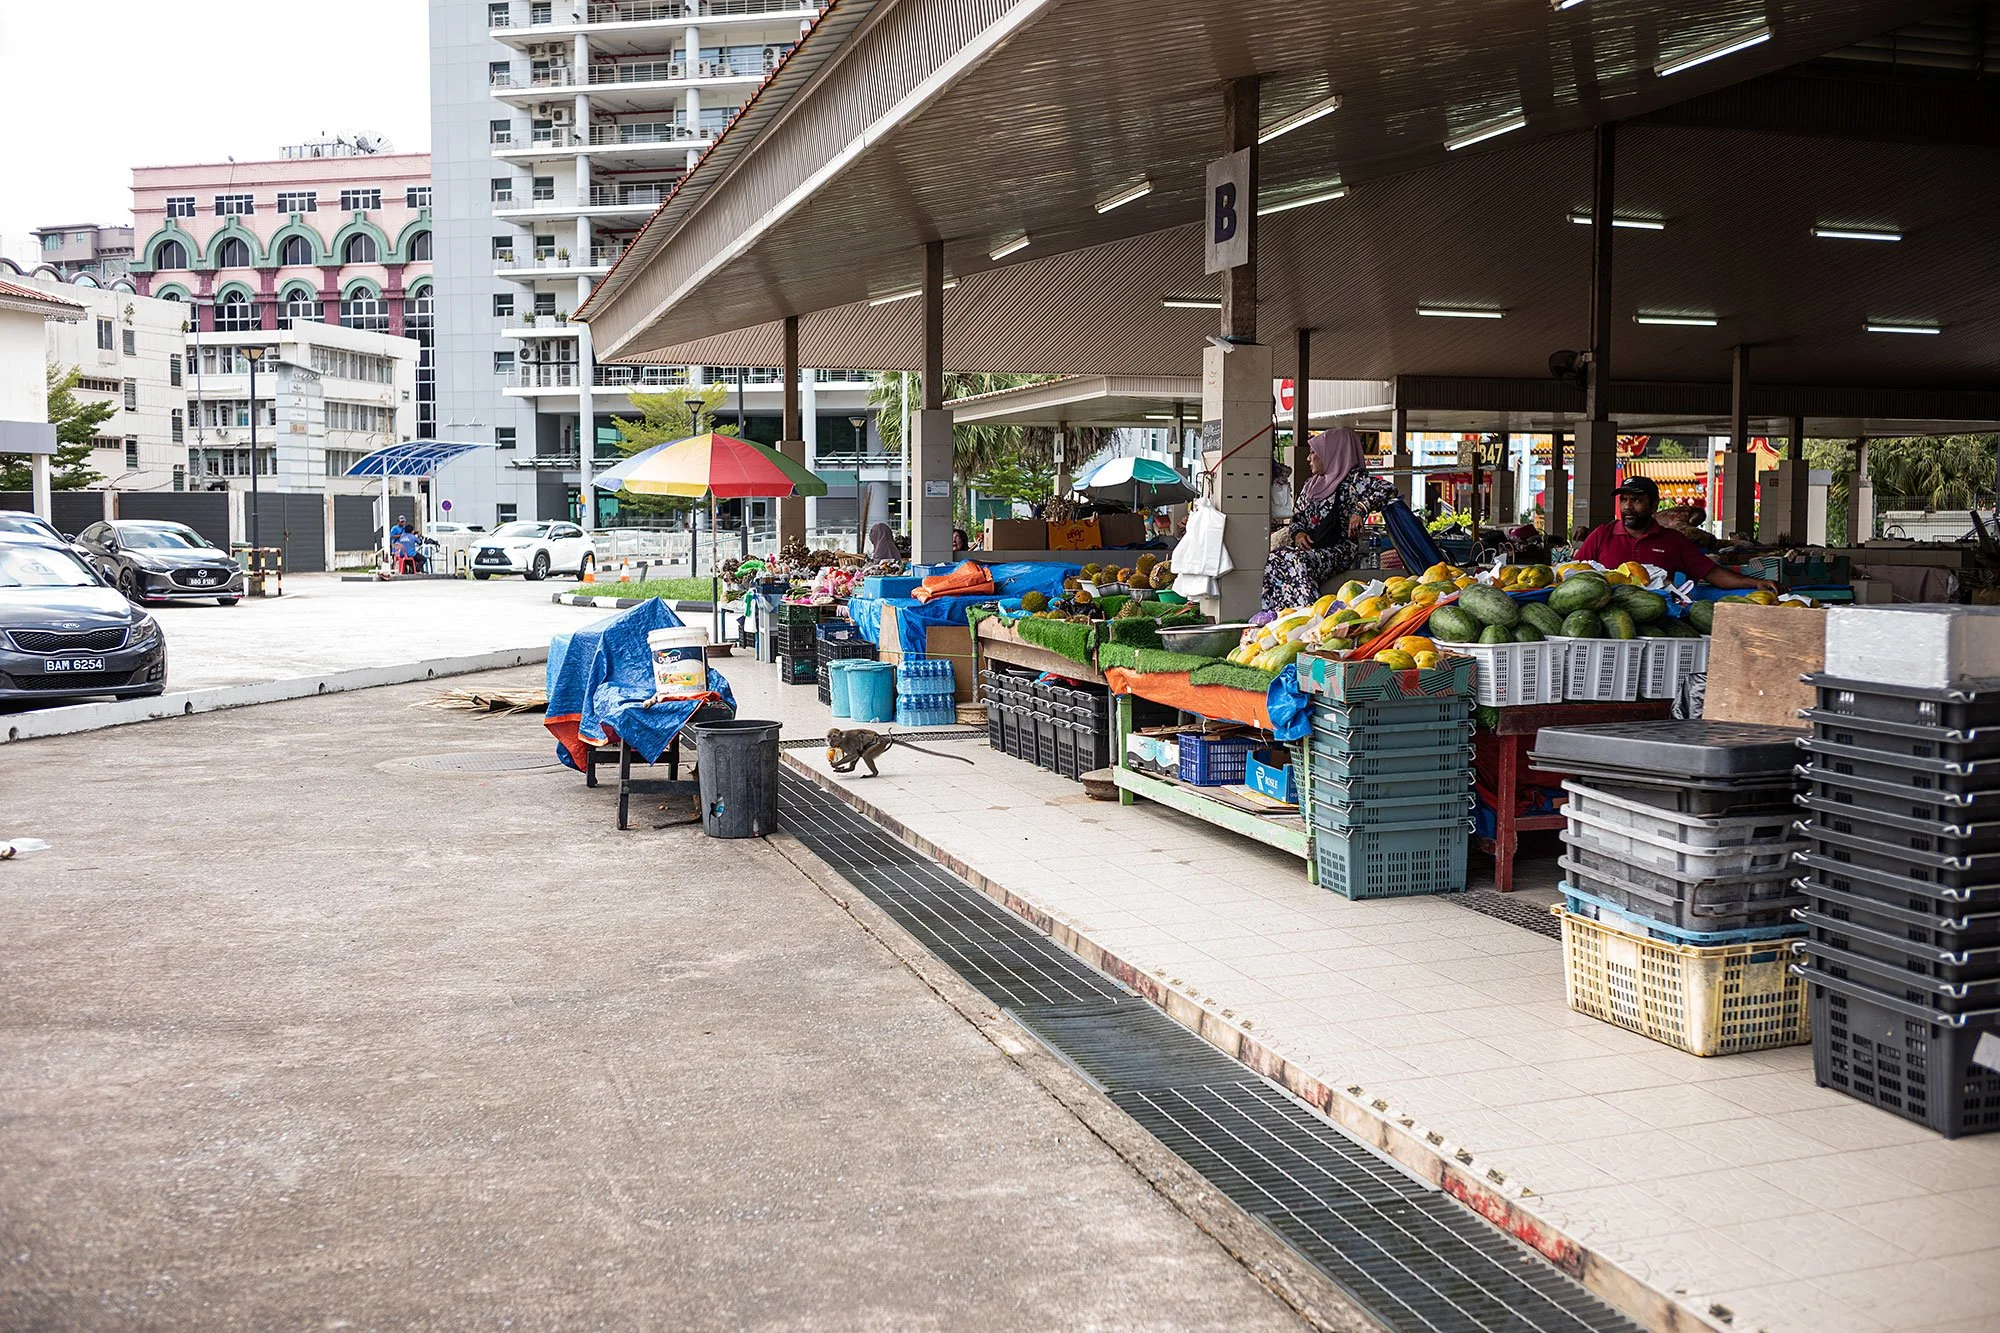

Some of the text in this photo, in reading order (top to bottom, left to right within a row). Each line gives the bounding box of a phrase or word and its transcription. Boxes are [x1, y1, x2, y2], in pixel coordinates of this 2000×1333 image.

[1214, 181, 1237, 245] B
[1170, 425, 1178, 444] A
[1055, 439, 1062, 456] A
[46, 659, 103, 671] BAM 6254
